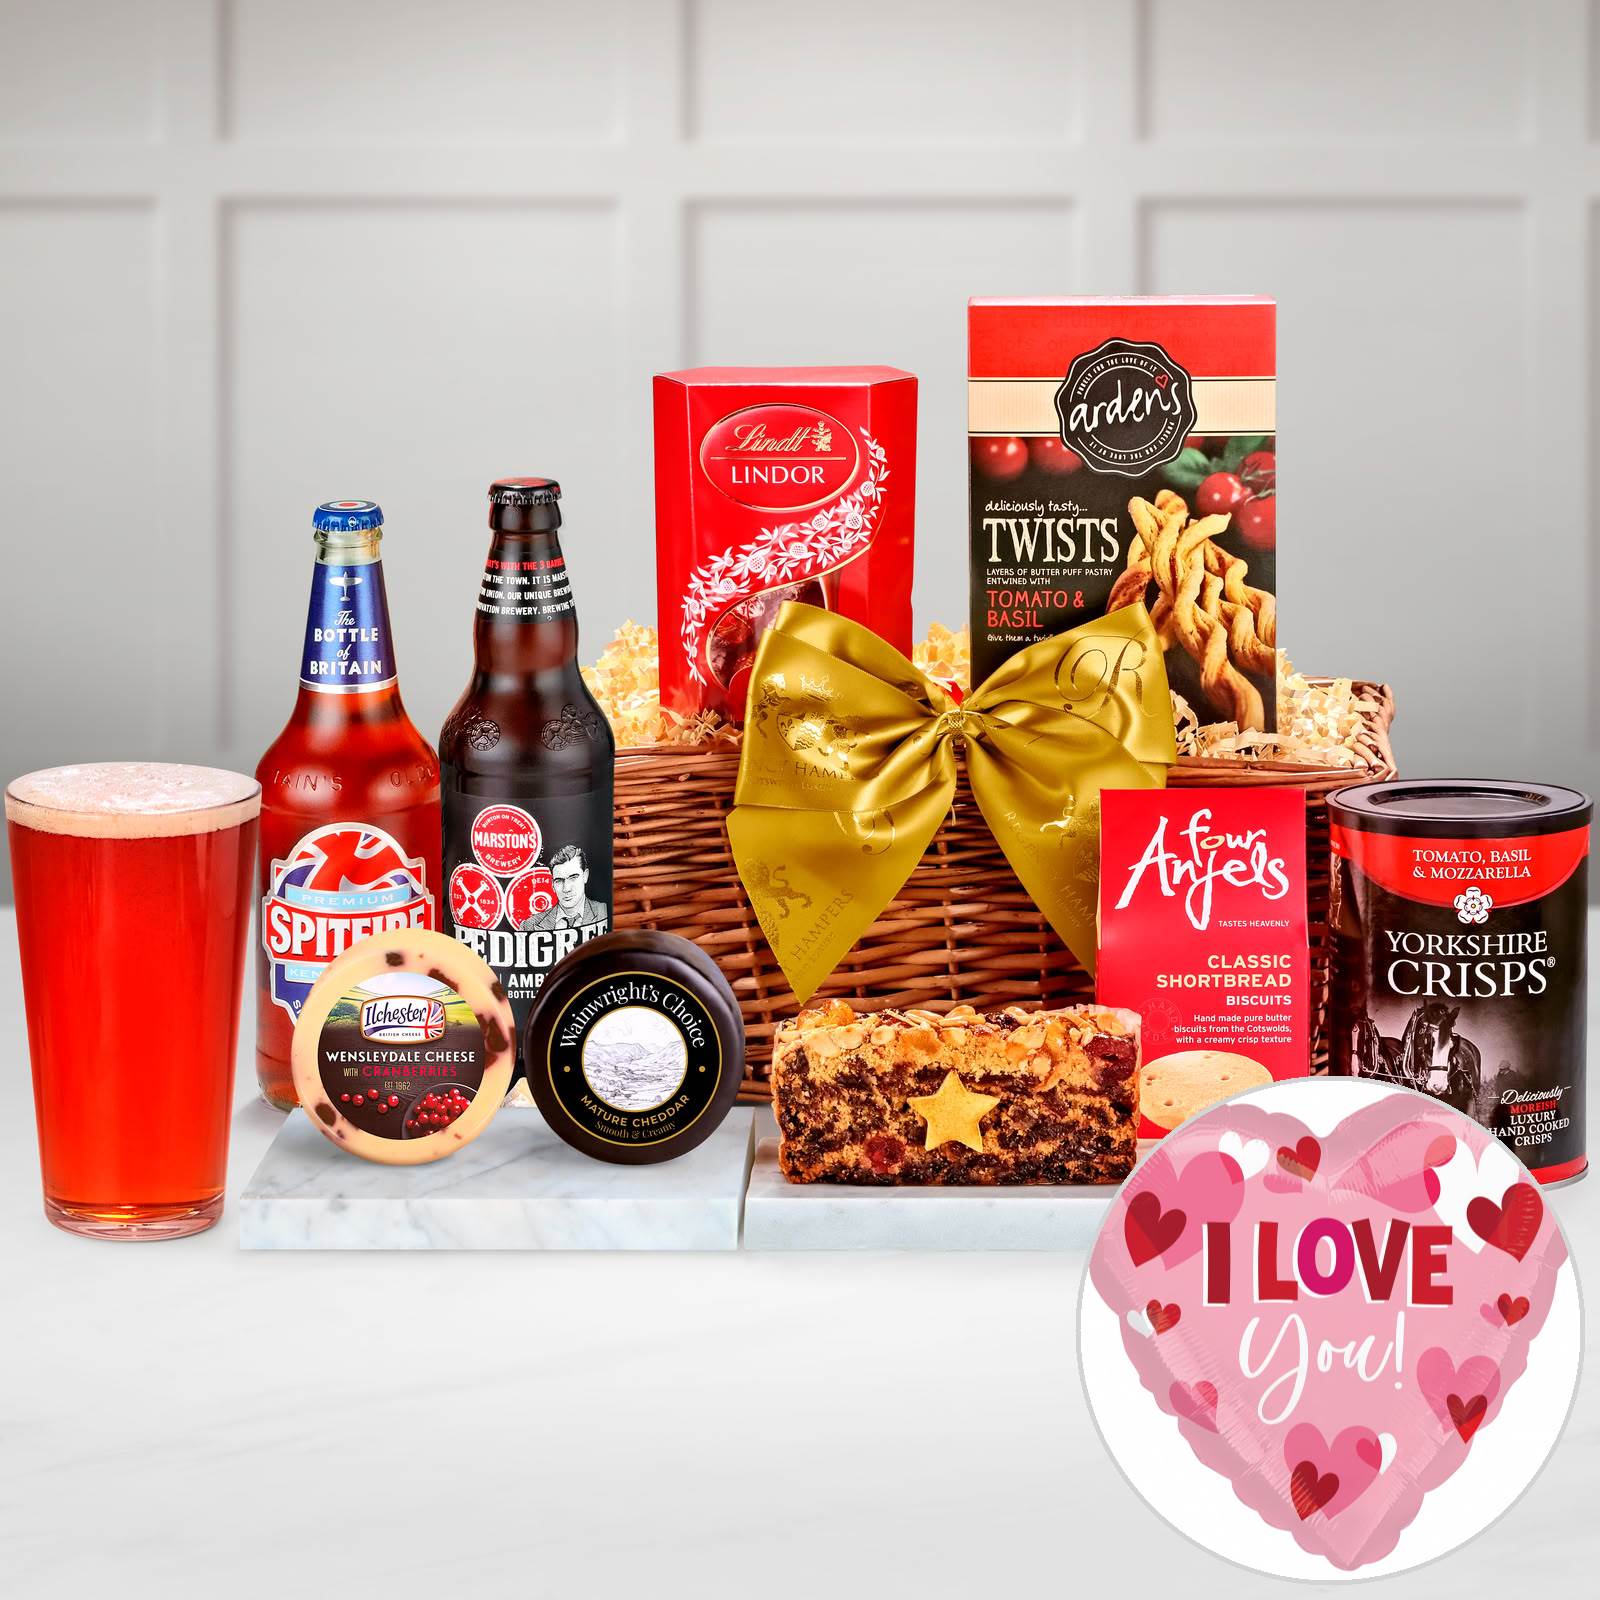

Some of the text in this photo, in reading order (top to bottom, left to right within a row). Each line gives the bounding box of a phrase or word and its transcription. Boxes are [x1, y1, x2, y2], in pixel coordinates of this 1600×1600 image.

[725, 423, 811, 453] Lindt
[732, 465, 825, 484] LINDOR
[985, 500, 1045, 517] deliciously
[983, 517, 1120, 563] TWISTS
[522, 561, 537, 571] THE
[987, 568, 1113, 576] LAYERS OF BUTTER PUFF PASTRY
[492, 573, 504, 585] THE
[506, 576, 530, 585] TOWN.
[532, 576, 540, 585] IT
[544, 575, 551, 585] IS
[508, 592, 522, 600] OUR
[524, 590, 552, 600] UNIQUE
[986, 590, 1085, 608] TOMATO &
[501, 606, 541, 615] BREWERY.
[543, 601, 569, 614] BREWING
[334, 610, 356, 626] The
[987, 610, 1044, 628] BASIL
[314, 628, 379, 643] BOTTLE
[1005, 634, 1023, 642] them
[336, 644, 352, 658] of
[310, 660, 382, 676] BRITAIN
[474, 831, 537, 849] MARSTON'S
[1180, 808, 1267, 867] four
[485, 853, 522, 867] BREWERY
[1413, 849, 1532, 864] TOMATO, BASIL
[1413, 866, 1532, 880] & MOZZARELLA
[302, 893, 395, 906] PREMIUM
[791, 888, 854, 960] HAMPERS
[1384, 930, 1548, 956] YORKSHIRE
[1208, 954, 1292, 969] CLASSIC
[508, 973, 548, 988] AMB
[1156, 973, 1292, 988] SHORTBREAD
[507, 990, 538, 999] BOTTL
[1226, 995, 1292, 1006] BISCUITS
[364, 1002, 427, 1026] Ilchester
[559, 981, 706, 1048] Wainwright's Choice
[1194, 1014, 1292, 1024] Hand made pure butter
[1174, 1024, 1292, 1033] biscuits from the Cotswolds,
[1176, 1035, 1195, 1043] with
[1204, 1037, 1235, 1045] creamy
[1237, 1035, 1259, 1045] crisp
[1261, 1036, 1292, 1044] texture
[326, 1051, 476, 1063] WENSLEYDALE CHEESE
[343, 1065, 458, 1078] WITH CRANBERRIES
[395, 1081, 411, 1090] 1962
[1500, 1085, 1564, 1105] Deliciously
[580, 1094, 691, 1128] MATURE CHEDDAR
[1510, 1100, 1557, 1114] MOREISH
[1510, 1110, 1557, 1126] LUXURY
[594, 1119, 677, 1140] Smooth & Creamy
[1488, 1117, 1570, 1137] HAND COOKED
[1514, 1132, 1553, 1147] CRISPS
[1202, 1217, 1454, 1308] I LOVE
[1238, 1310, 1406, 1425] You!
